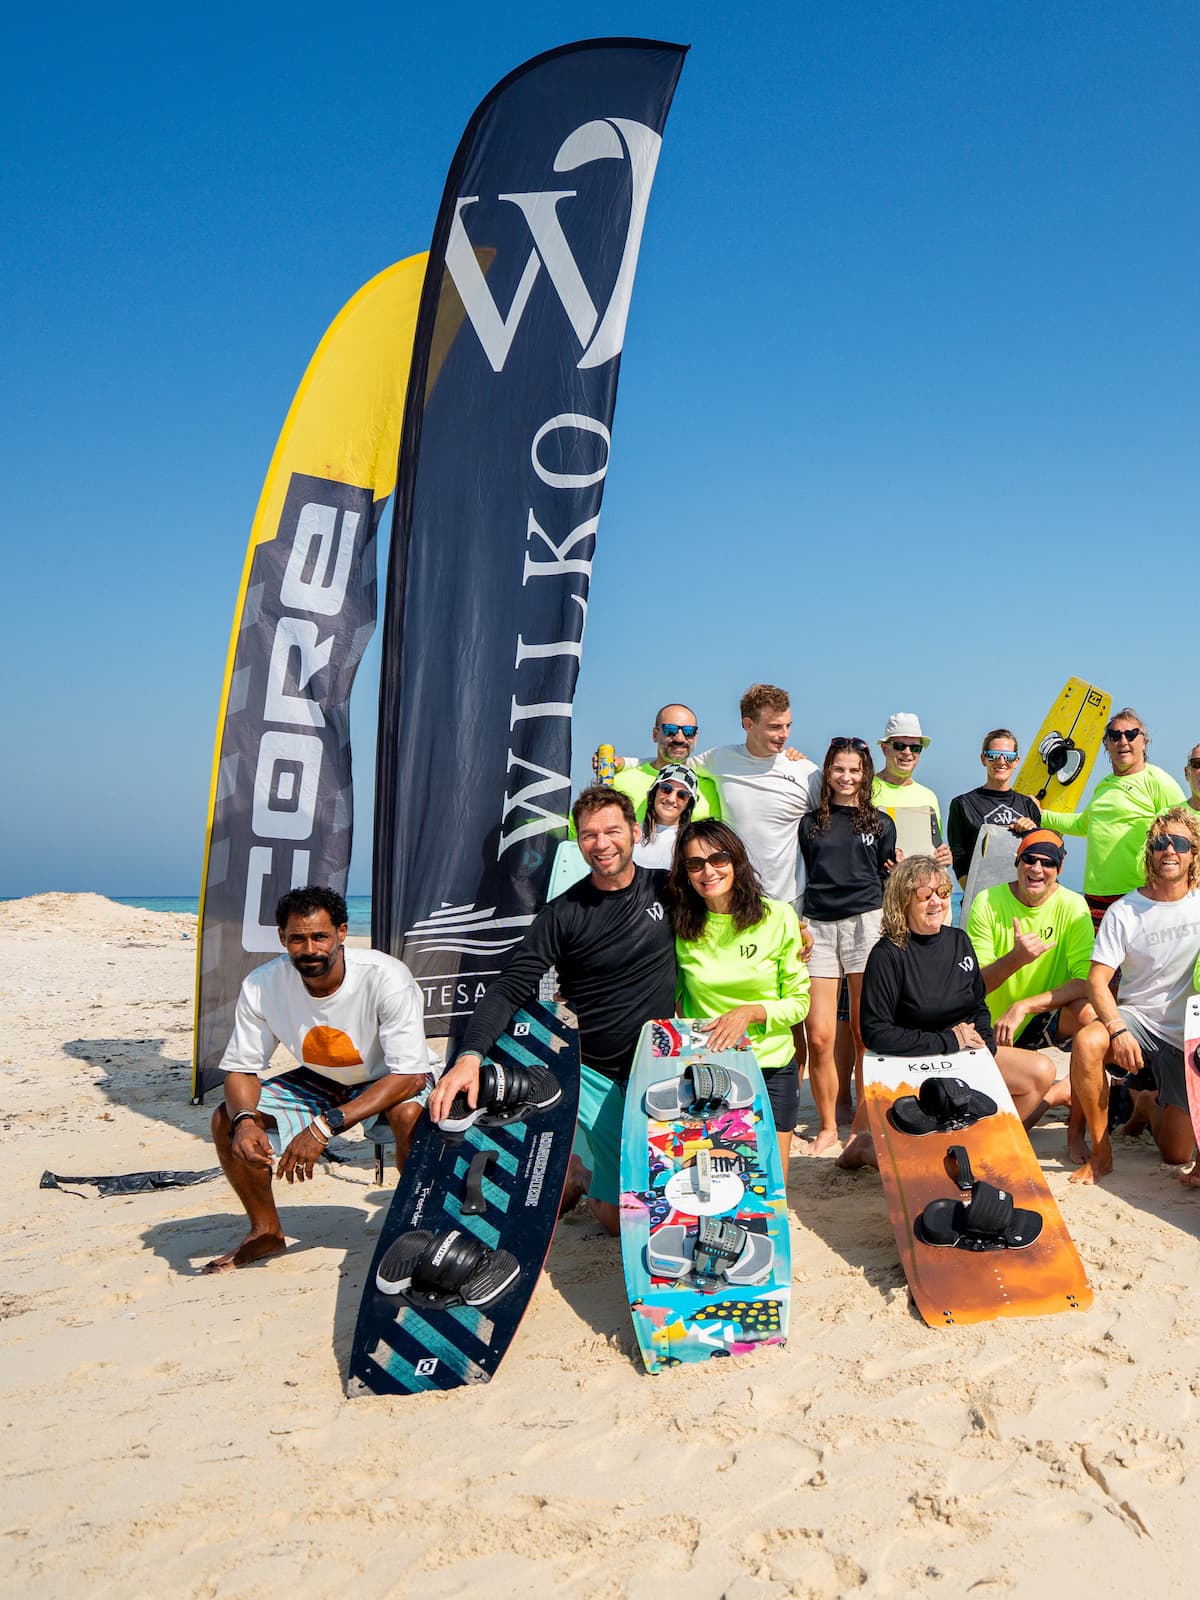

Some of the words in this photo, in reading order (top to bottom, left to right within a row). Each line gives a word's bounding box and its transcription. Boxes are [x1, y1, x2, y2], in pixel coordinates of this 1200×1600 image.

[241, 502, 361, 954] CORE
[497, 413, 611, 861] WILKO
[908, 1061, 952, 1072] KOLD
